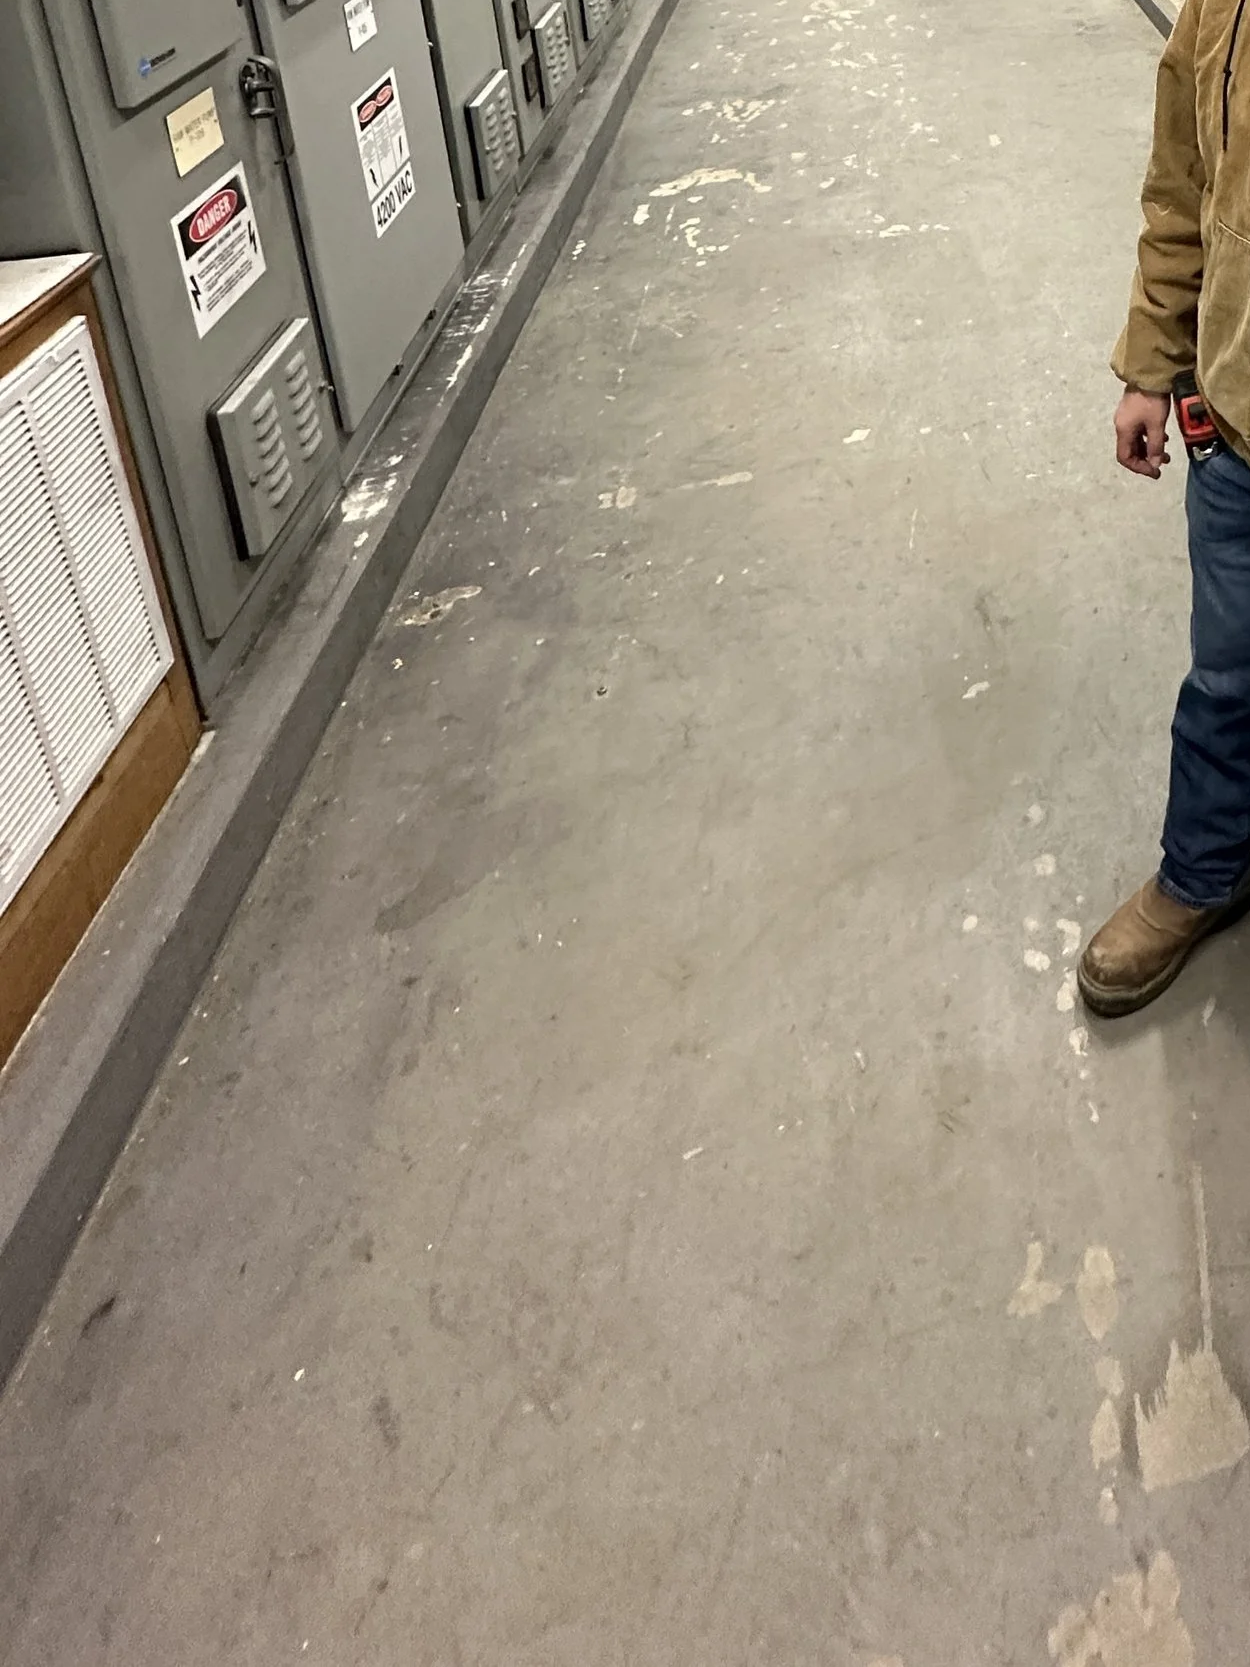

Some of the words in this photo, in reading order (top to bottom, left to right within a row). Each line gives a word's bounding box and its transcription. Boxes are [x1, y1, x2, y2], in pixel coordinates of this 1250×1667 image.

[196, 194, 231, 236] DANGER
[377, 191, 395, 227] 4200
[394, 170, 413, 204] VAC
